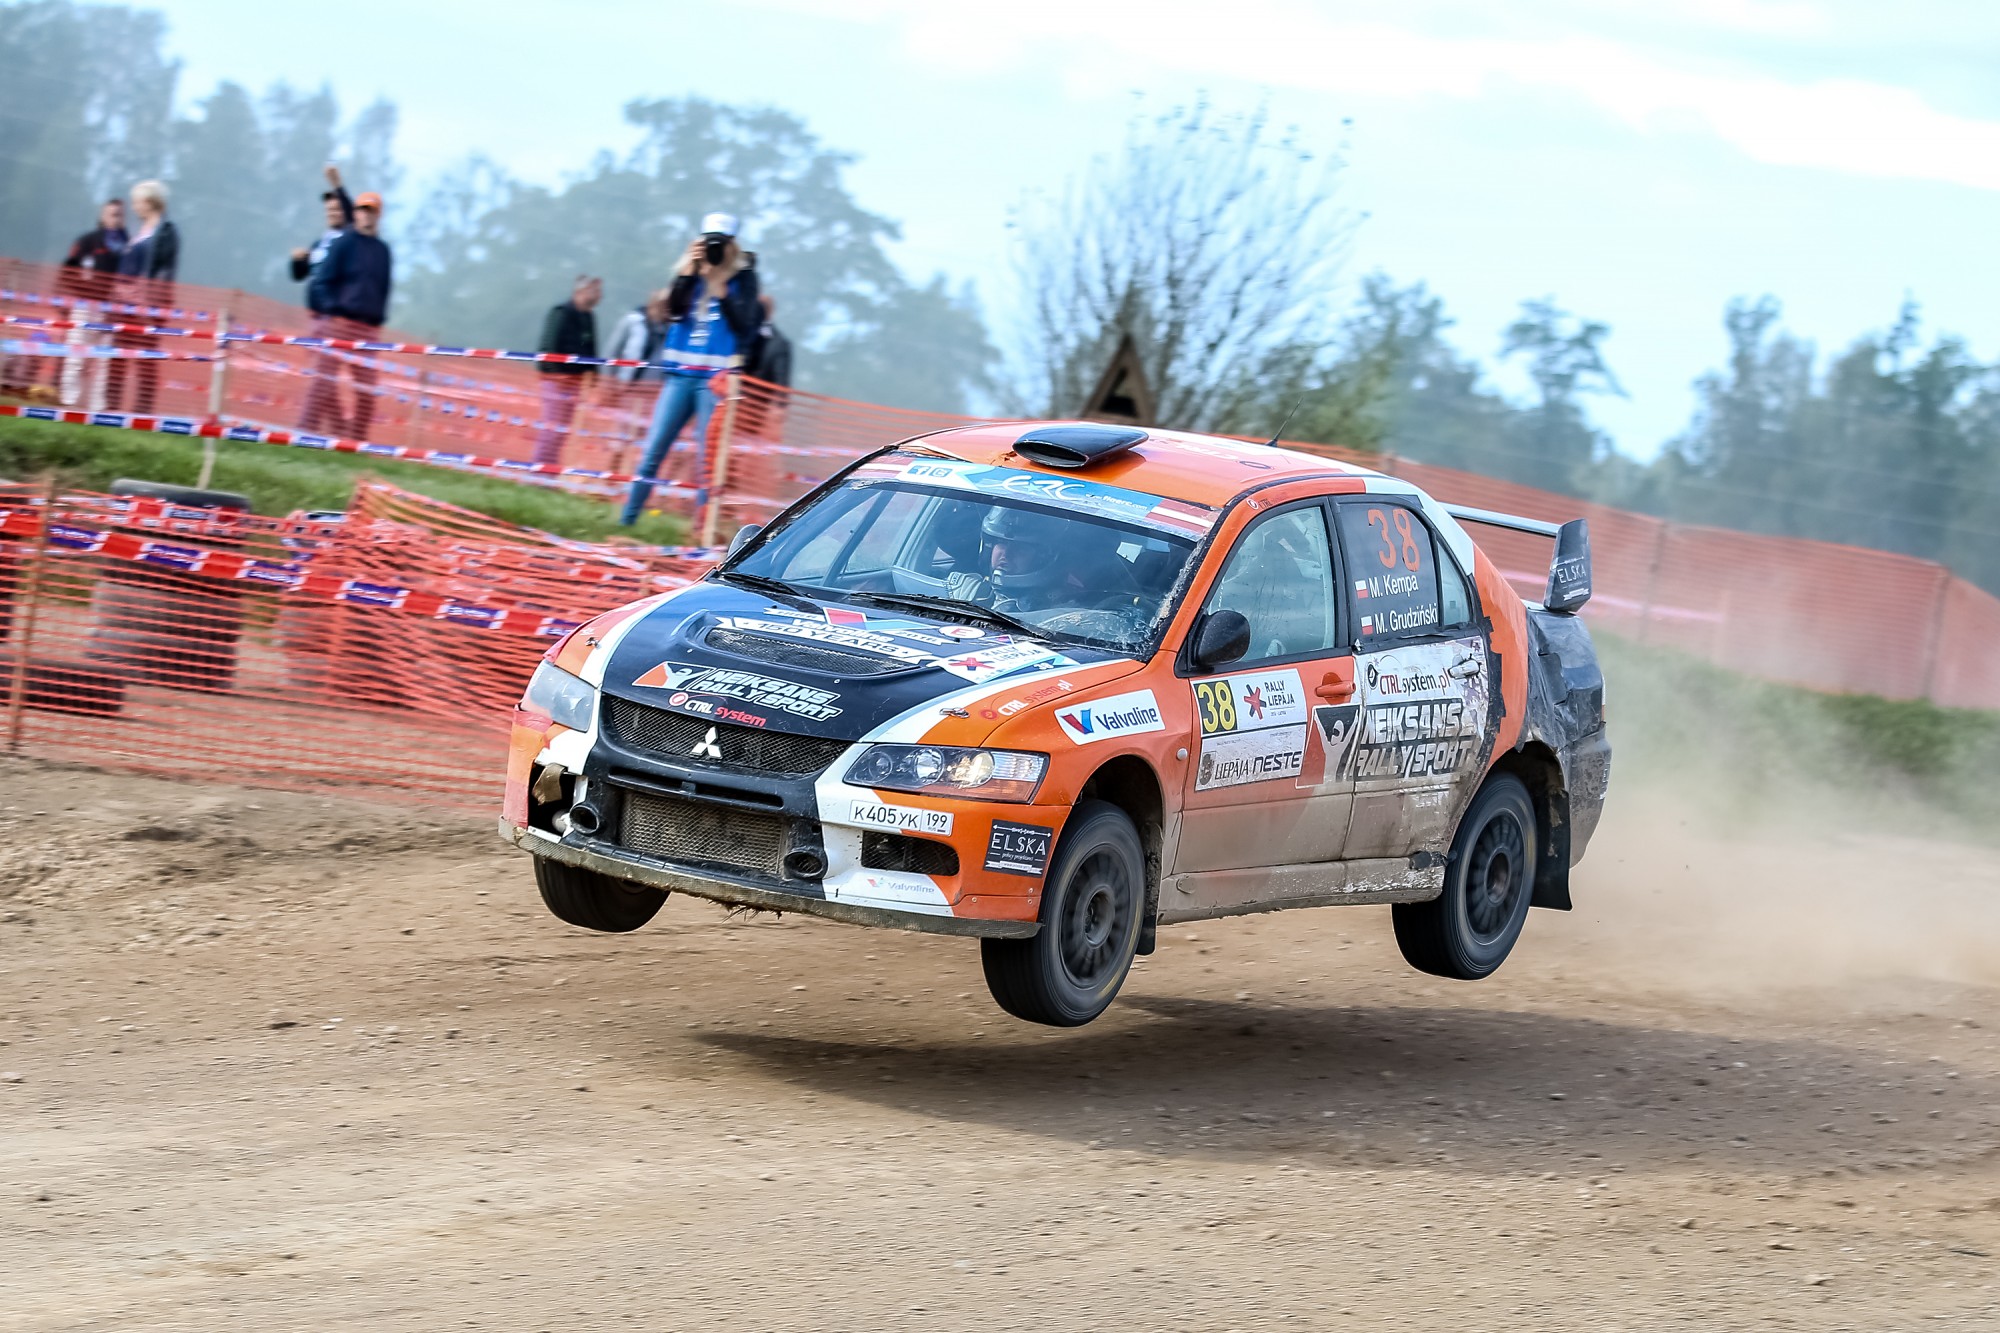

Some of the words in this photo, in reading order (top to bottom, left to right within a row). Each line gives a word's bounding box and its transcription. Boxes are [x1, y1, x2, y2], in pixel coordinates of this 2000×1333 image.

[1002, 475, 1085, 500] ERC
[1367, 508, 1420, 572] 38
[1369, 576, 1383, 598] M.
[1383, 574, 1418, 598] Kempa
[1557, 564, 1587, 584] ELSKA
[793, 618, 895, 643] Valvoline
[1374, 612, 1388, 634] M.
[1389, 602, 1438, 631] Grudziński
[758, 622, 803, 634] 150
[805, 629, 897, 653] YEARS
[709, 670, 836, 705] NEIKSANS
[1264, 680, 1285, 693] RALLY
[1267, 691, 1295, 707] LIEPĀJA
[684, 700, 712, 714] CTRL
[714, 706, 767, 728] system
[1095, 707, 1159, 731] Valvoline
[1197, 681, 1236, 733] 38
[1360, 702, 1462, 745] NEIKSANS
[1215, 758, 1249, 780] LIEPĀJA
[1253, 751, 1303, 775] NESTE
[926, 812, 948, 828] 199
[991, 832, 1046, 856] ELSKA
[888, 881, 935, 894] Valvoline
